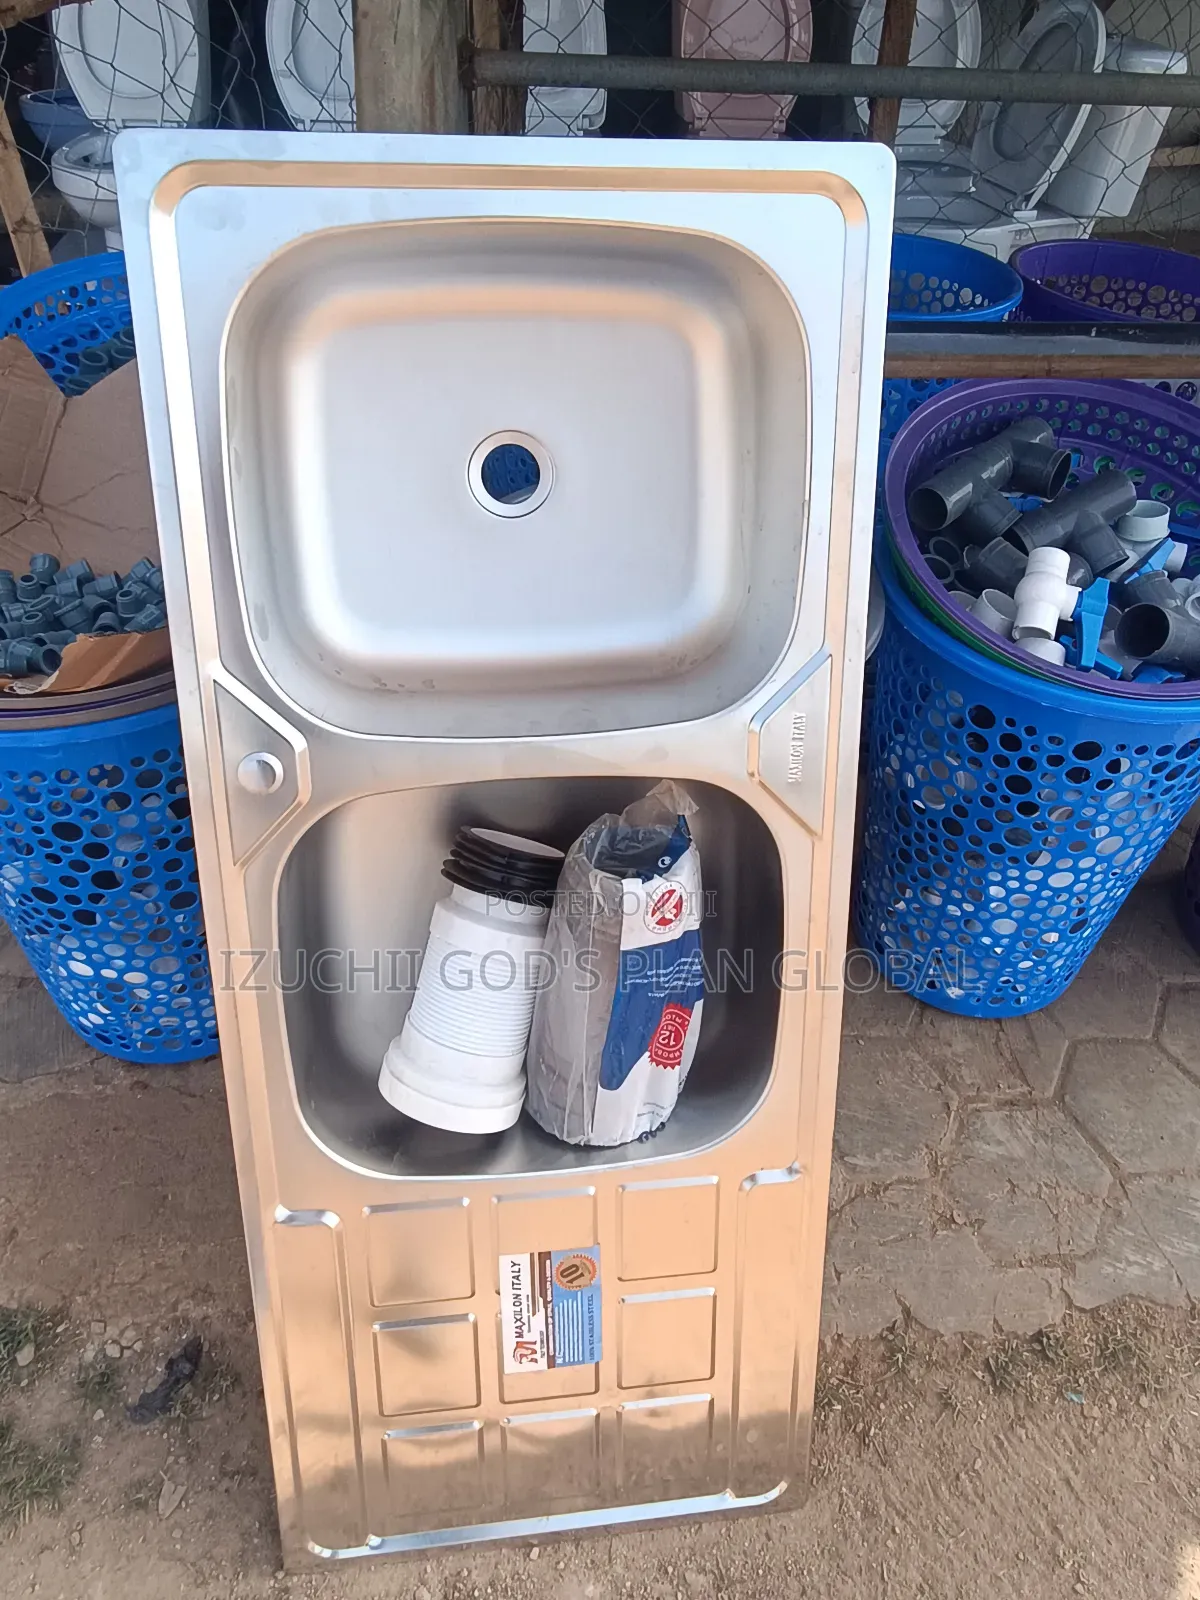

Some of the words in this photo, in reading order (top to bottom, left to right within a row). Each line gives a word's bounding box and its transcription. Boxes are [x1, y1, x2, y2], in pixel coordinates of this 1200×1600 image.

[658, 1030, 676, 1046] 12
[510, 1260, 522, 1291] ITALY
[560, 1263, 585, 1285] 10
[512, 1293, 526, 1338] MAXILON
